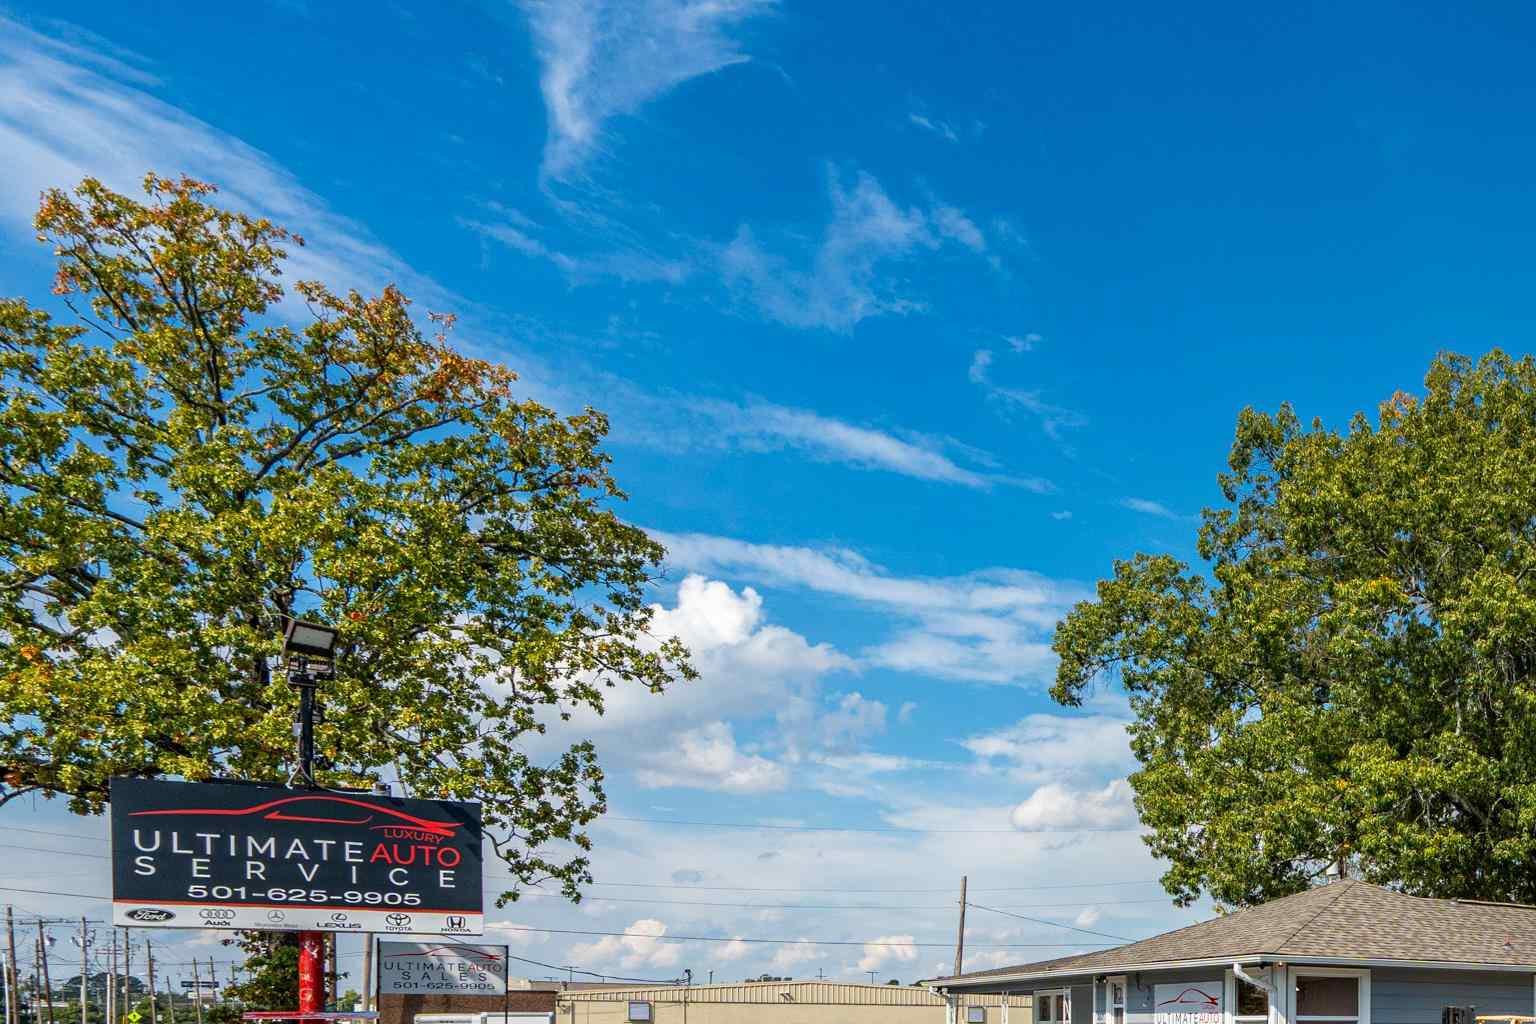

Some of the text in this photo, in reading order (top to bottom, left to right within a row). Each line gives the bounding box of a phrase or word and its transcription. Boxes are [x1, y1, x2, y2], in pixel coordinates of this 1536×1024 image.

[384, 828, 445, 844] LUXURY
[133, 829, 461, 867] ULTIMATE AUTO
[134, 855, 456, 888] SERVICE
[187, 884, 422, 906] 501-625-9905
[133, 909, 168, 921] Ford
[316, 921, 362, 929] LEXUS
[384, 960, 464, 973] ULTIMATE
[401, 971, 488, 982] SALES
[392, 981, 496, 991] 501-625-9905
[1156, 1011, 1199, 1024] ULTIMATE
